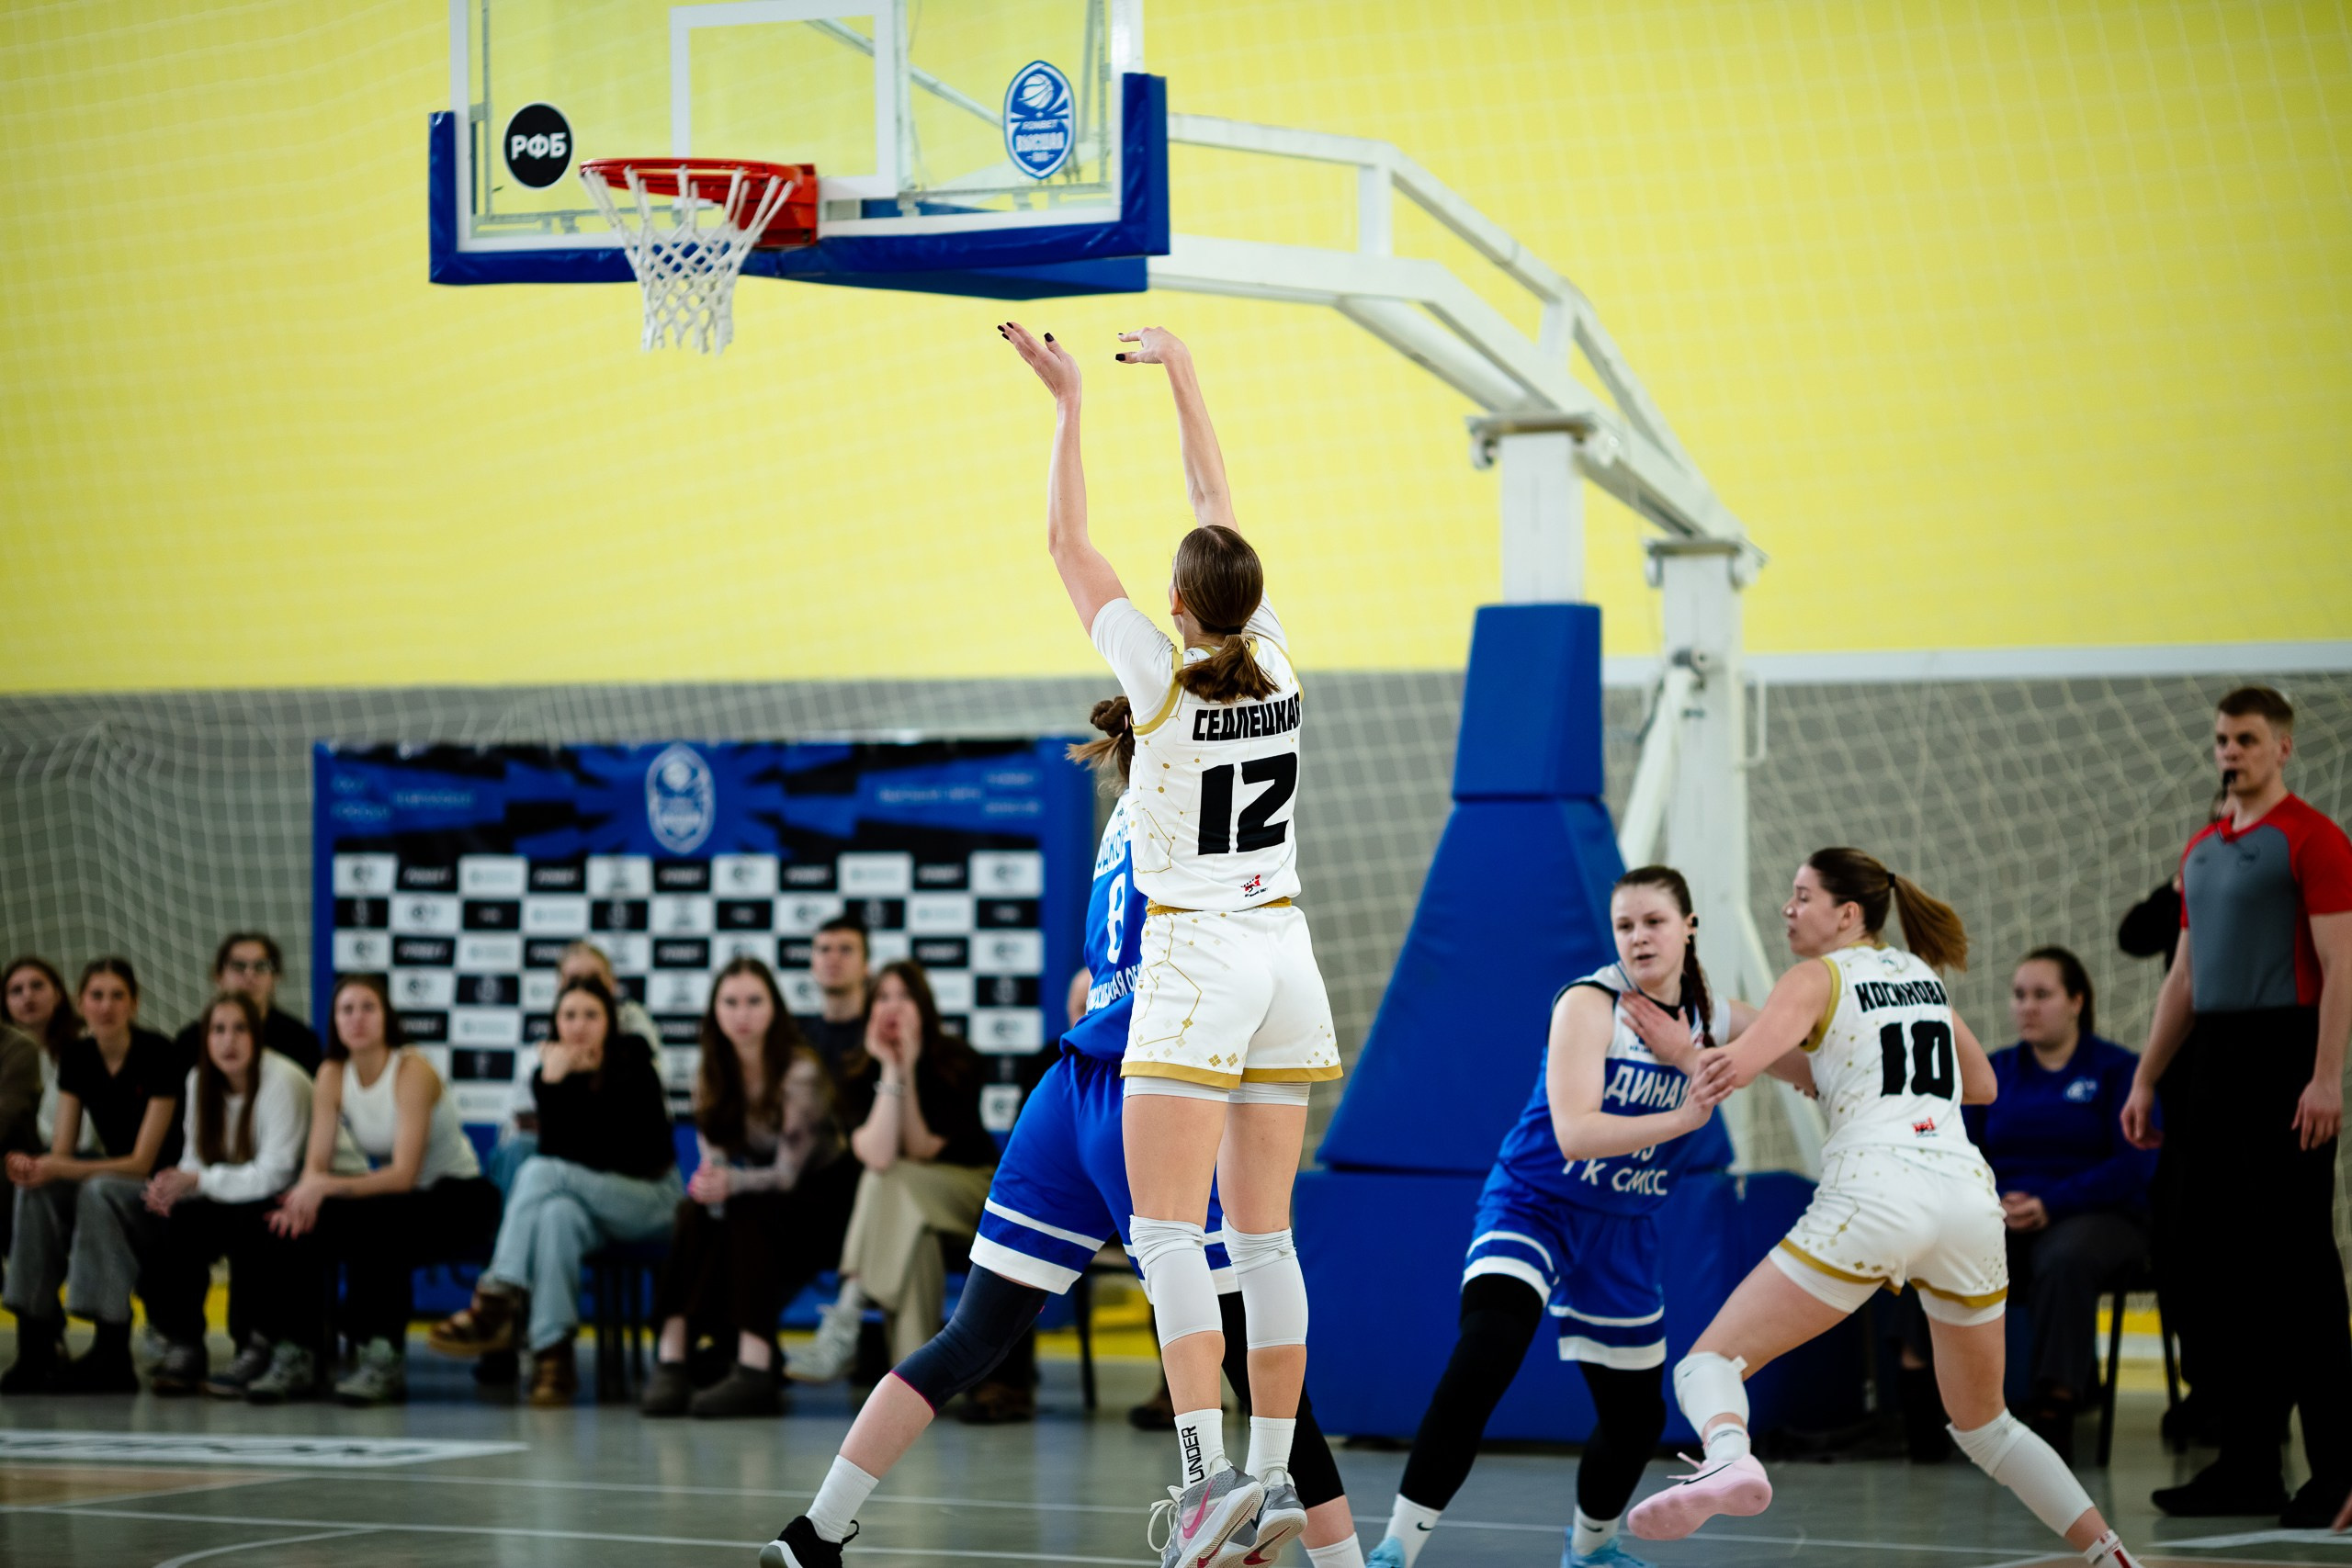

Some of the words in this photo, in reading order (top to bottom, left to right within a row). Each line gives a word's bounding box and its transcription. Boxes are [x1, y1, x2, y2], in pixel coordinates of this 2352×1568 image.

[511, 132, 567, 160] РФБ
[1197, 751, 1297, 855] 12
[1881, 1021, 1954, 1101] 10
[1611, 1167, 1668, 1196] СМСС
[1182, 1425, 1205, 1484] UNDER
